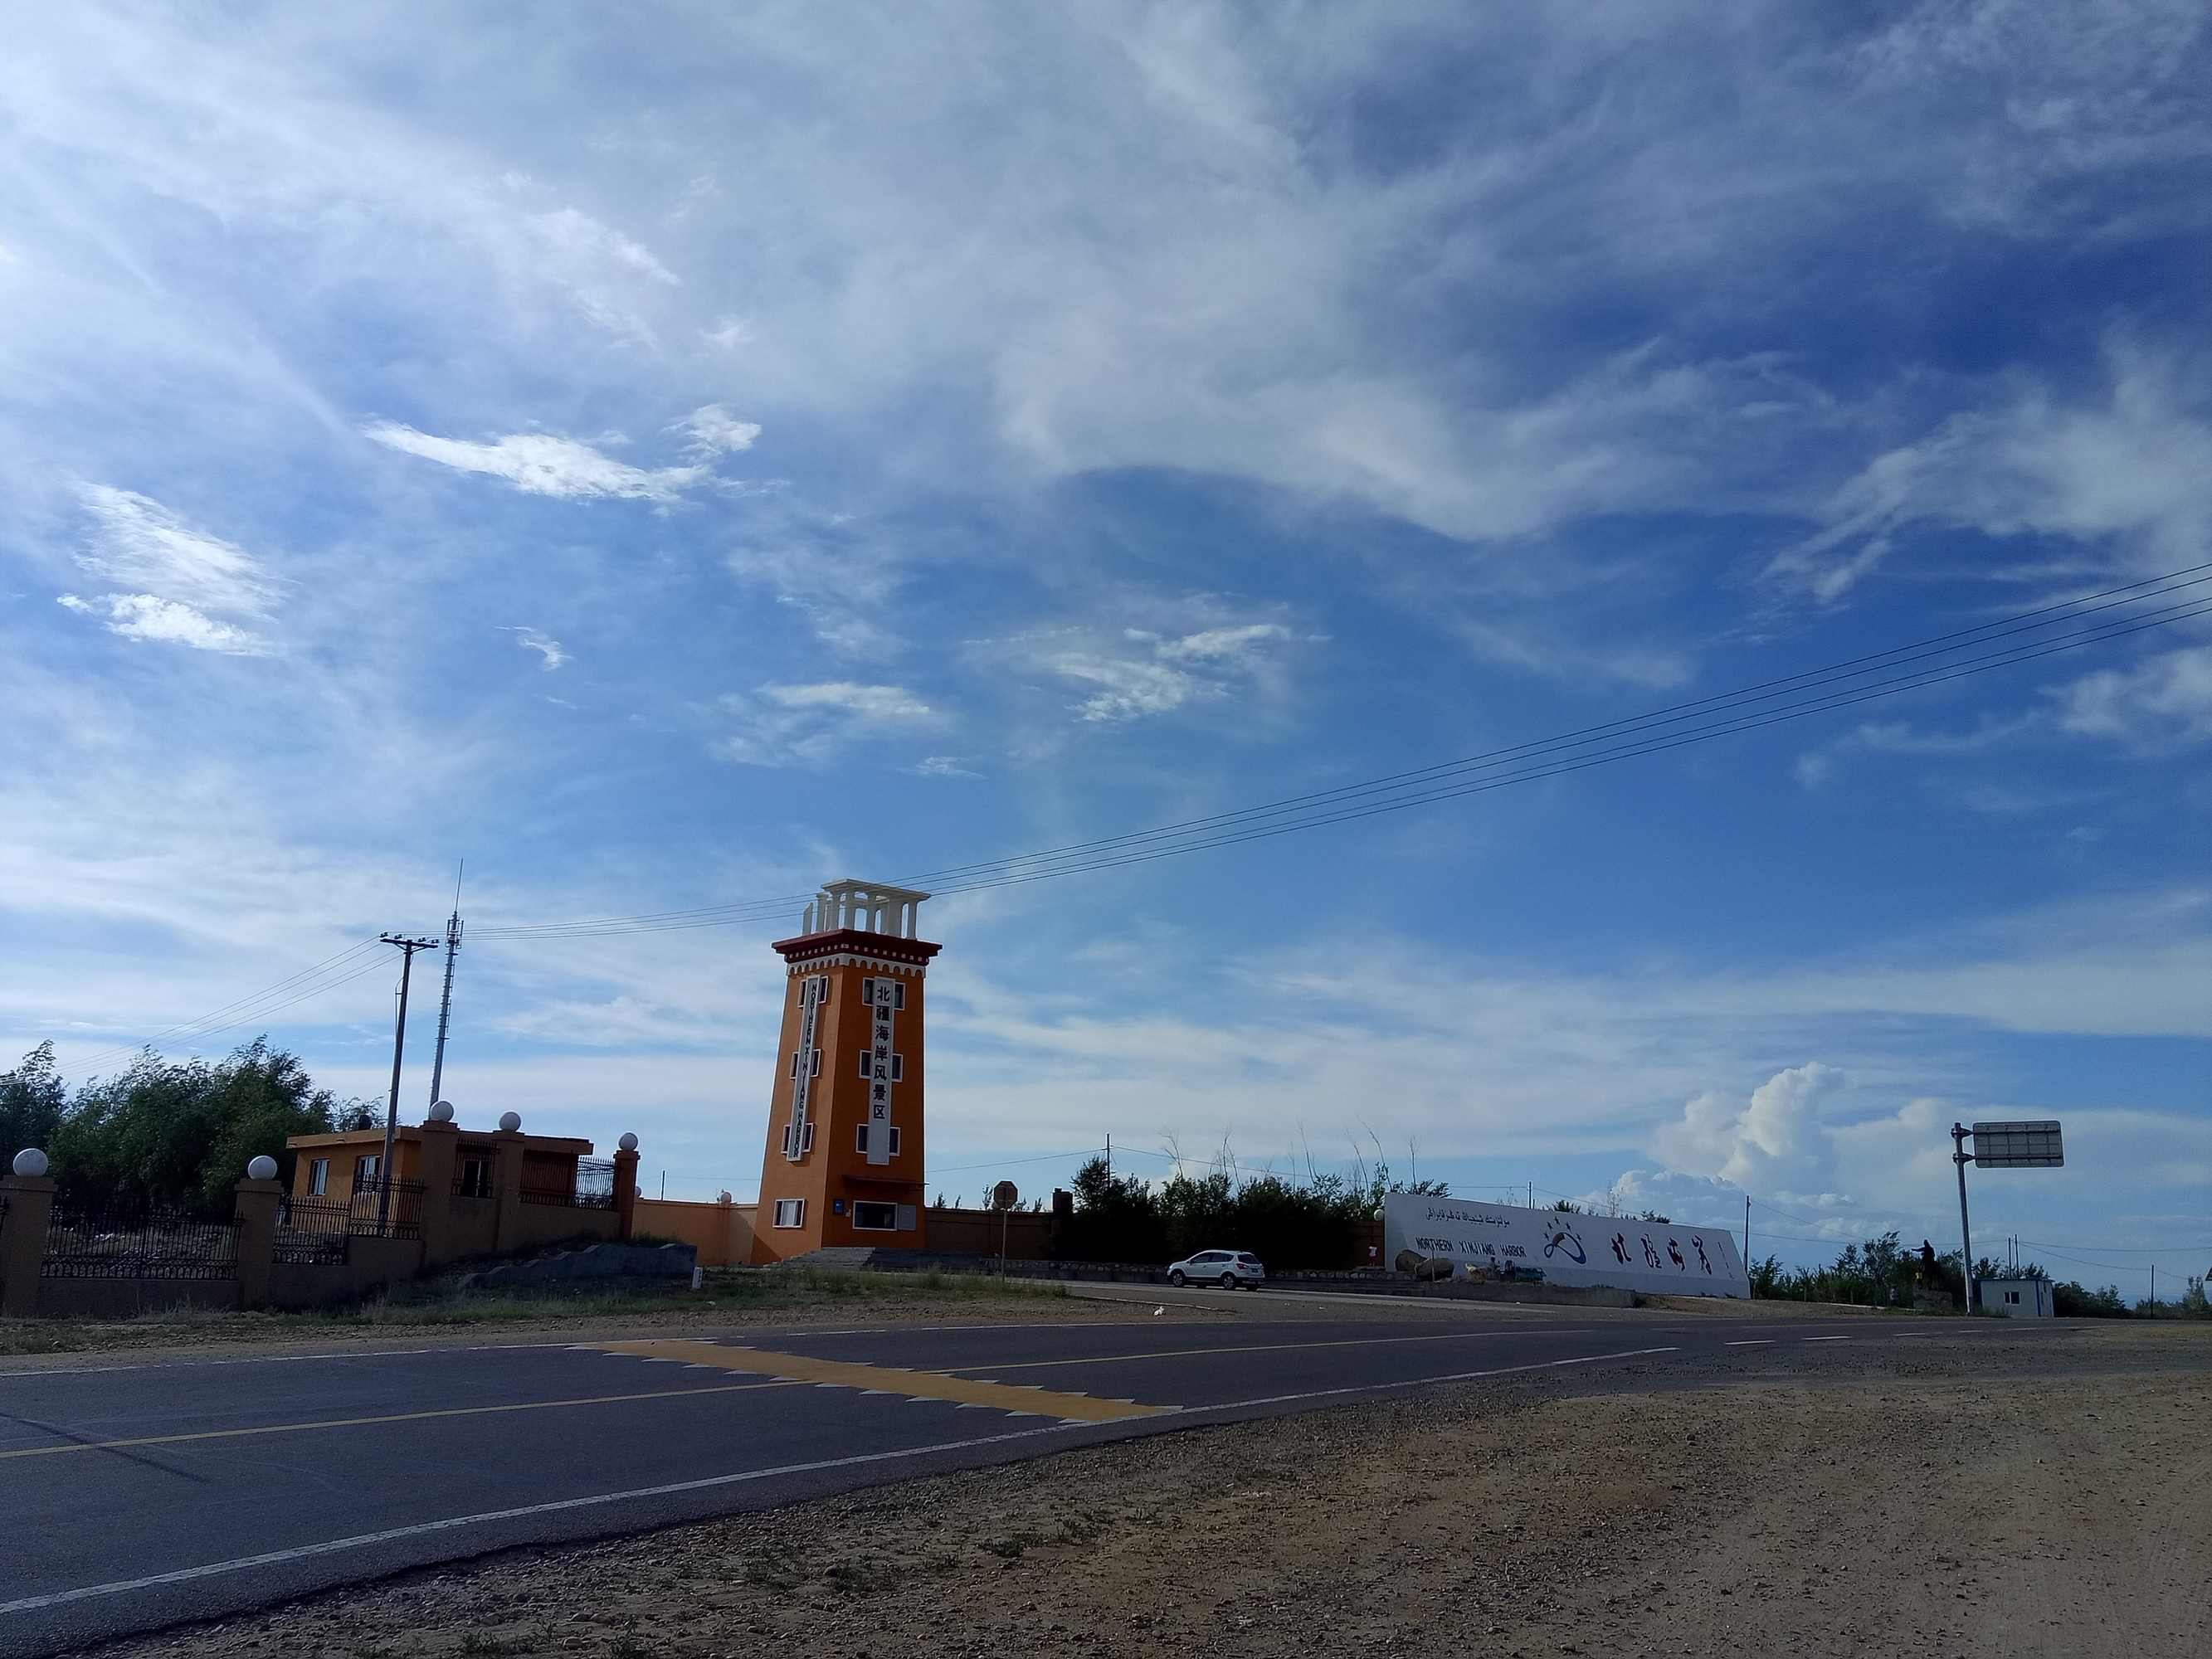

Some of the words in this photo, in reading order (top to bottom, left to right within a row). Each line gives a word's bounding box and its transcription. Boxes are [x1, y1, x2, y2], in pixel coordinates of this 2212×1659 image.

[806, 984, 817, 1045] NORTHERN
[798, 1046, 810, 1110] XINJIANG
[873, 986, 890, 1119] 北疆海岸风景区
[793, 1111, 803, 1158] HARBOR
[1415, 1238, 1454, 1252] NORTHERN
[1459, 1241, 1496, 1255] XINJIANG
[1500, 1244, 1527, 1258] HARBOR
